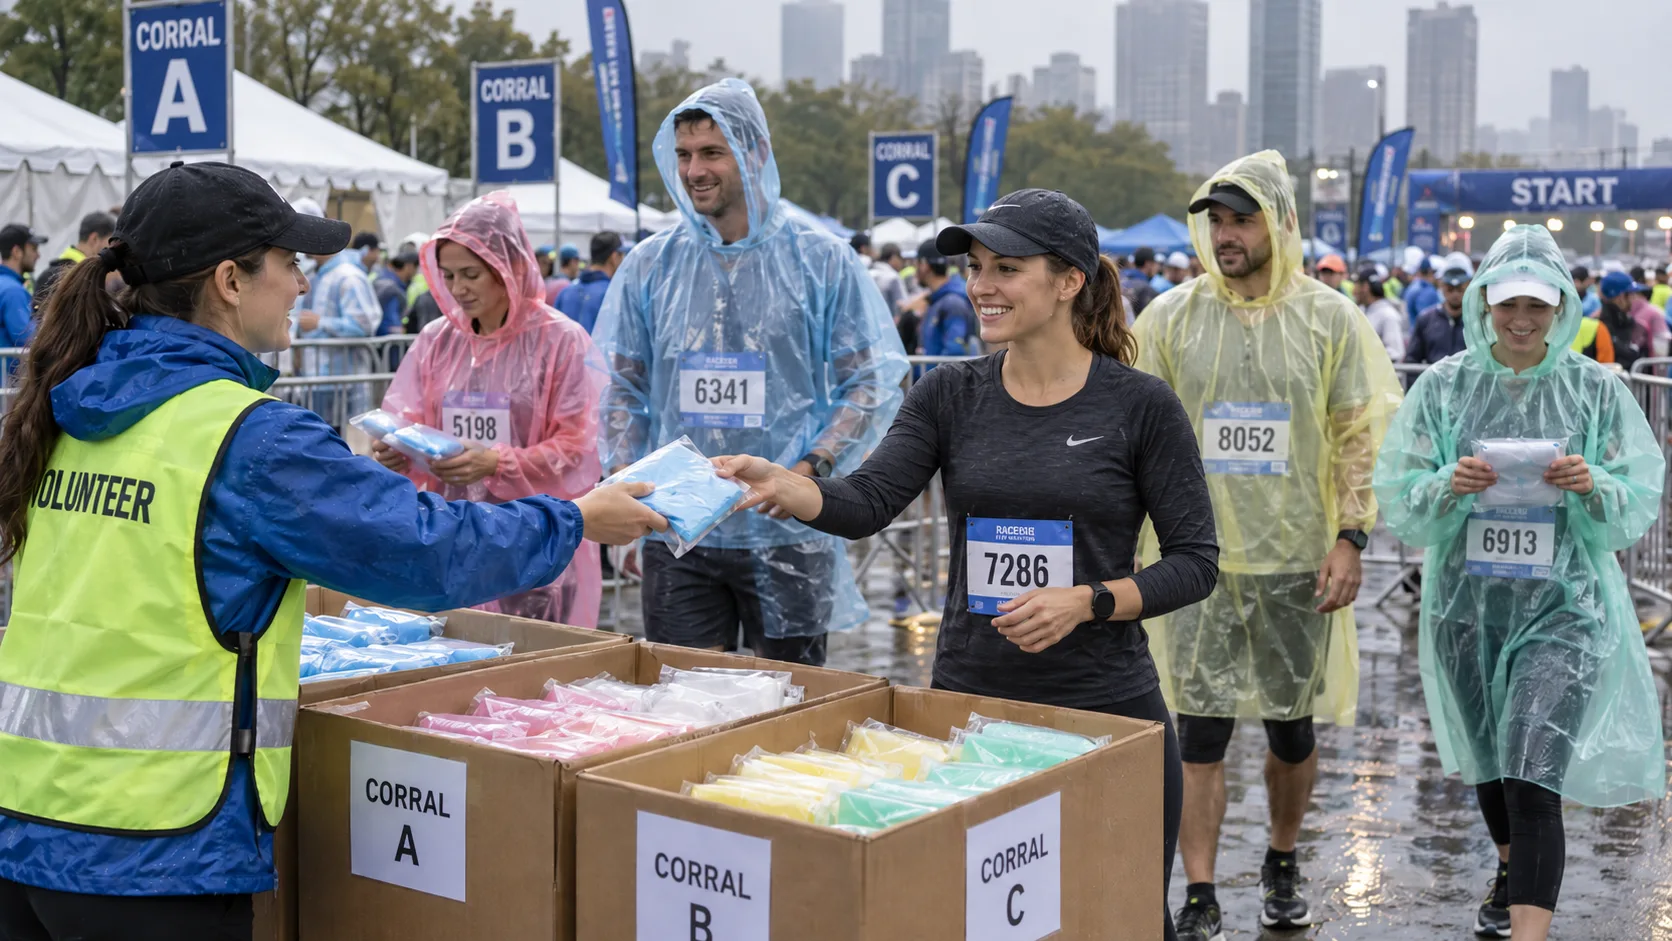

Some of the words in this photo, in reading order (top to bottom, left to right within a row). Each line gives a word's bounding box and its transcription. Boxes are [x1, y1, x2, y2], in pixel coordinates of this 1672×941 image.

[136, 16, 221, 52] CORRAL
[151, 58, 208, 135] A
[481, 75, 551, 103] CORRAL
[496, 108, 536, 170] B
[886, 163, 919, 209] C
[1511, 176, 1619, 206] START
[695, 377, 748, 405] 6341
[453, 415, 497, 440] 5198
[1218, 426, 1275, 452] 8052
[1483, 527, 1537, 556] 6913
[984, 552, 1049, 588] 7286
[365, 777, 451, 818] CORRAL
[394, 824, 420, 866] A
[981, 833, 1049, 884] CORRAL
[654, 852, 752, 900] CORRAL
[690, 902, 713, 941] B
[1006, 883, 1025, 927] C
